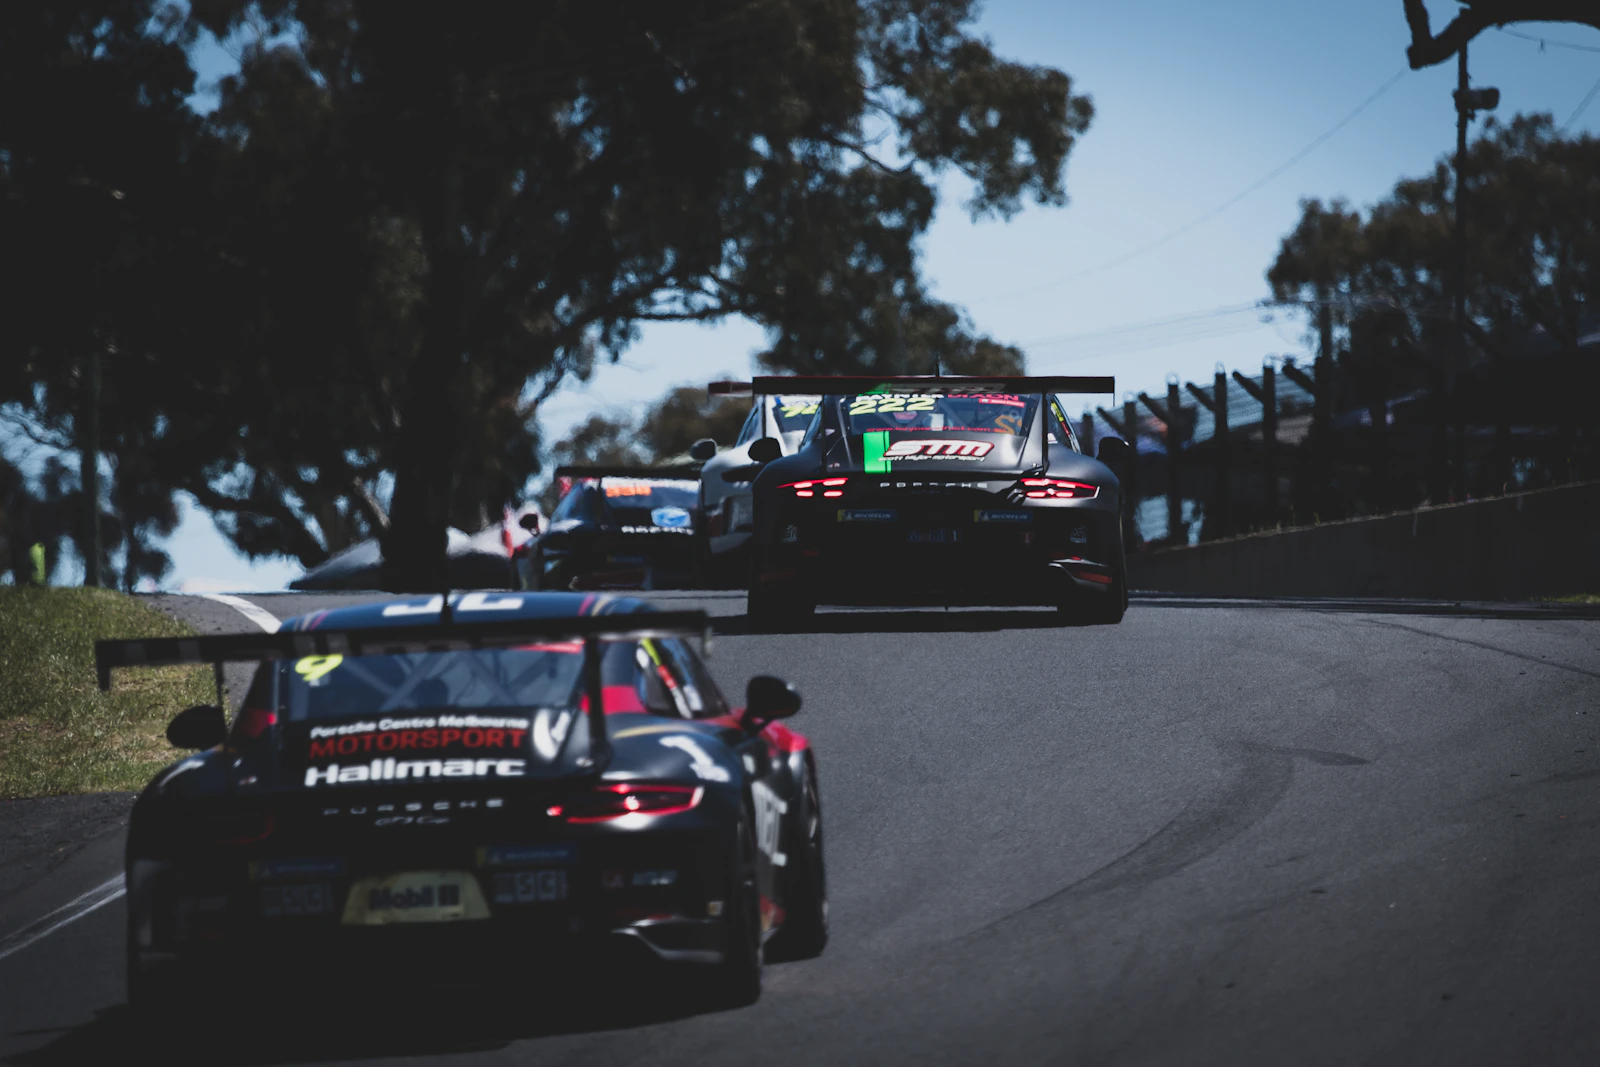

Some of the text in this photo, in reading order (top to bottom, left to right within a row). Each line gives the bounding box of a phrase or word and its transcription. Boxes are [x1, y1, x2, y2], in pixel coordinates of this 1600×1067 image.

[849, 398, 936, 416] 222
[883, 439, 994, 457] STM
[294, 653, 343, 682] 9
[310, 716, 529, 739] Porsche Centre Melbourne
[309, 728, 527, 759] MOTORSPORT
[304, 757, 528, 787] Hallmarc
[323, 798, 504, 815] PORSCHE
[369, 885, 433, 909] Mobil
